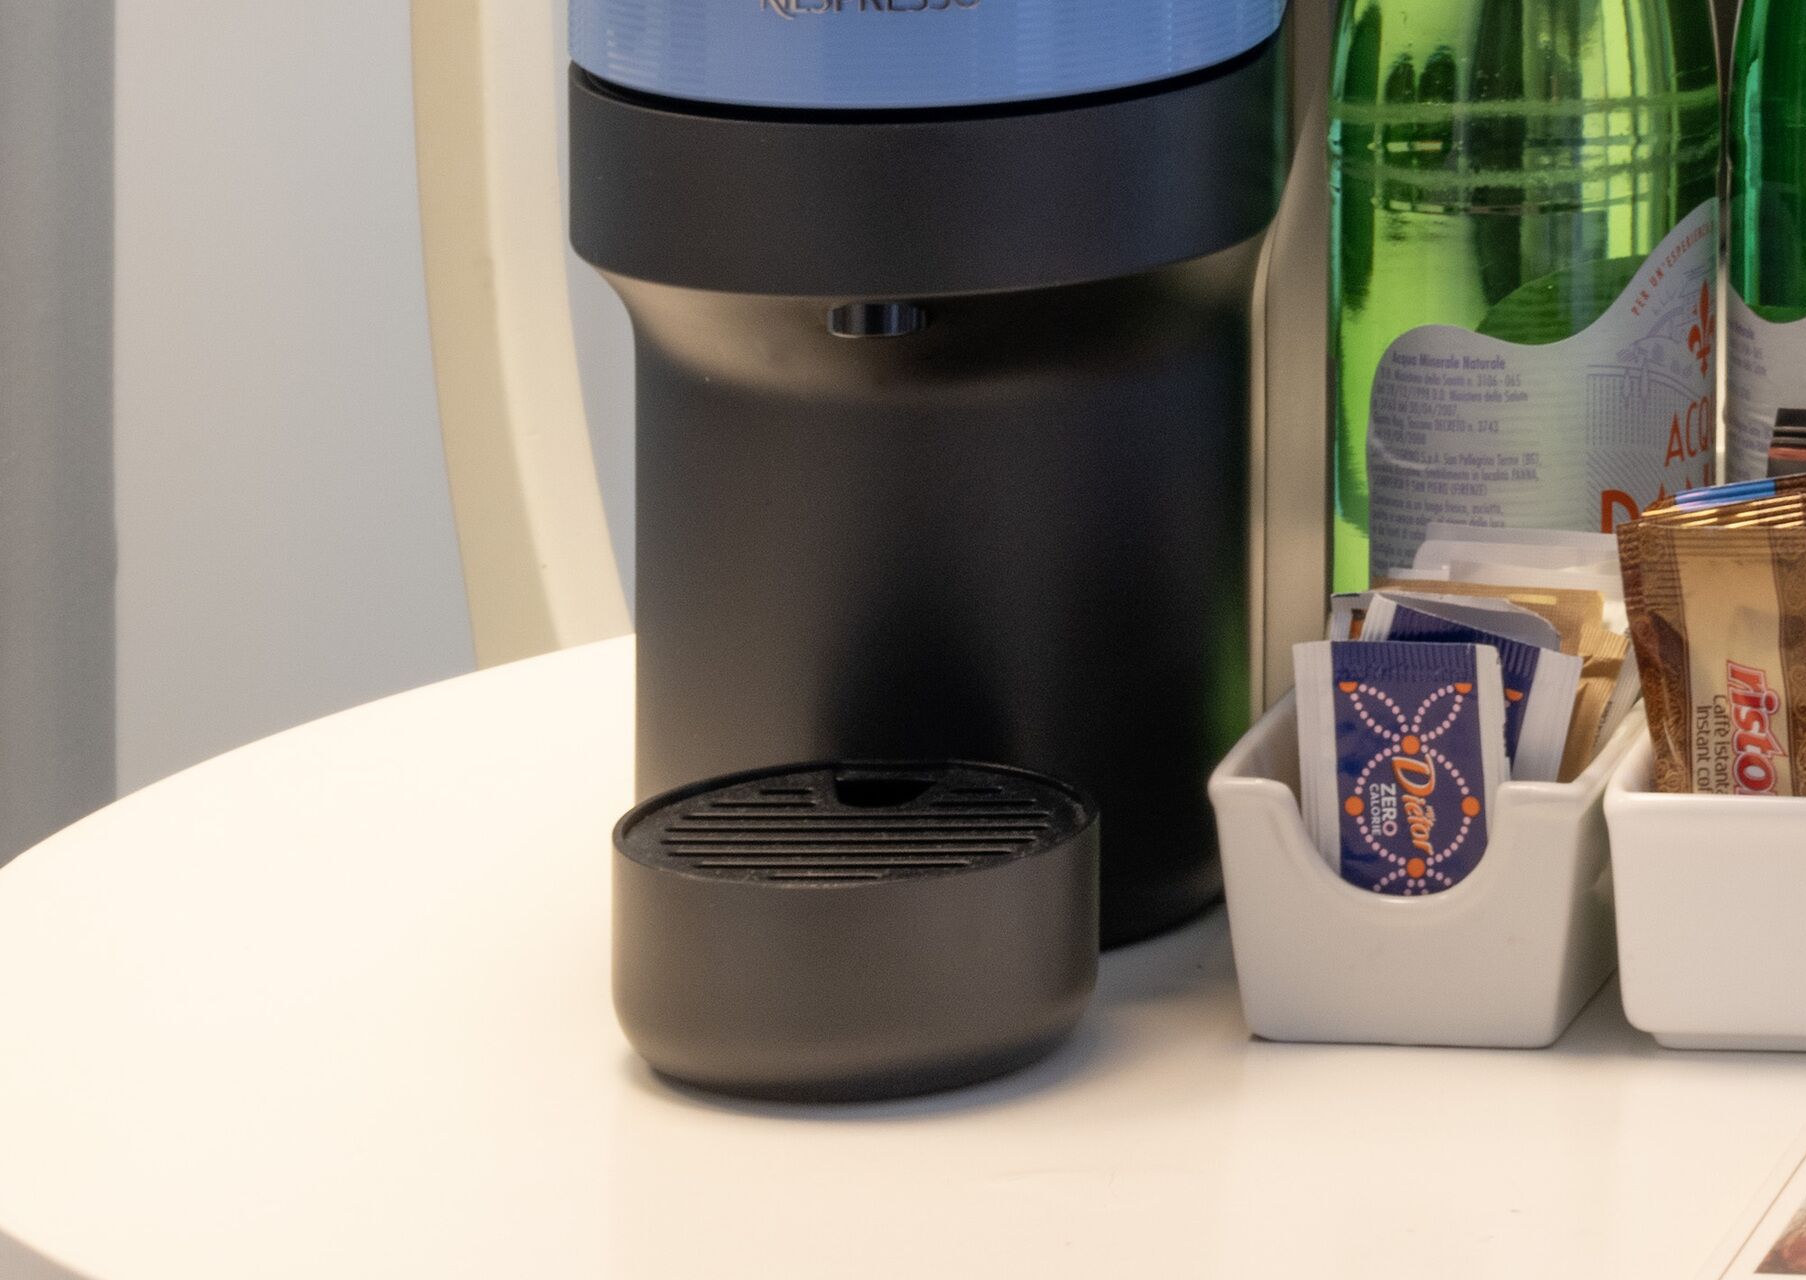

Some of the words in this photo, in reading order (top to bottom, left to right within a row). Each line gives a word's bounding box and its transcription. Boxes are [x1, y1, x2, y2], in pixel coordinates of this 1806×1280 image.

[1462, 354, 1506, 371] Naturale
[1696, 705, 1713, 763] Instant
[1726, 660, 1787, 795] risto
[1369, 783, 1382, 836] CALORIE
[1380, 782, 1398, 837] ZERO
